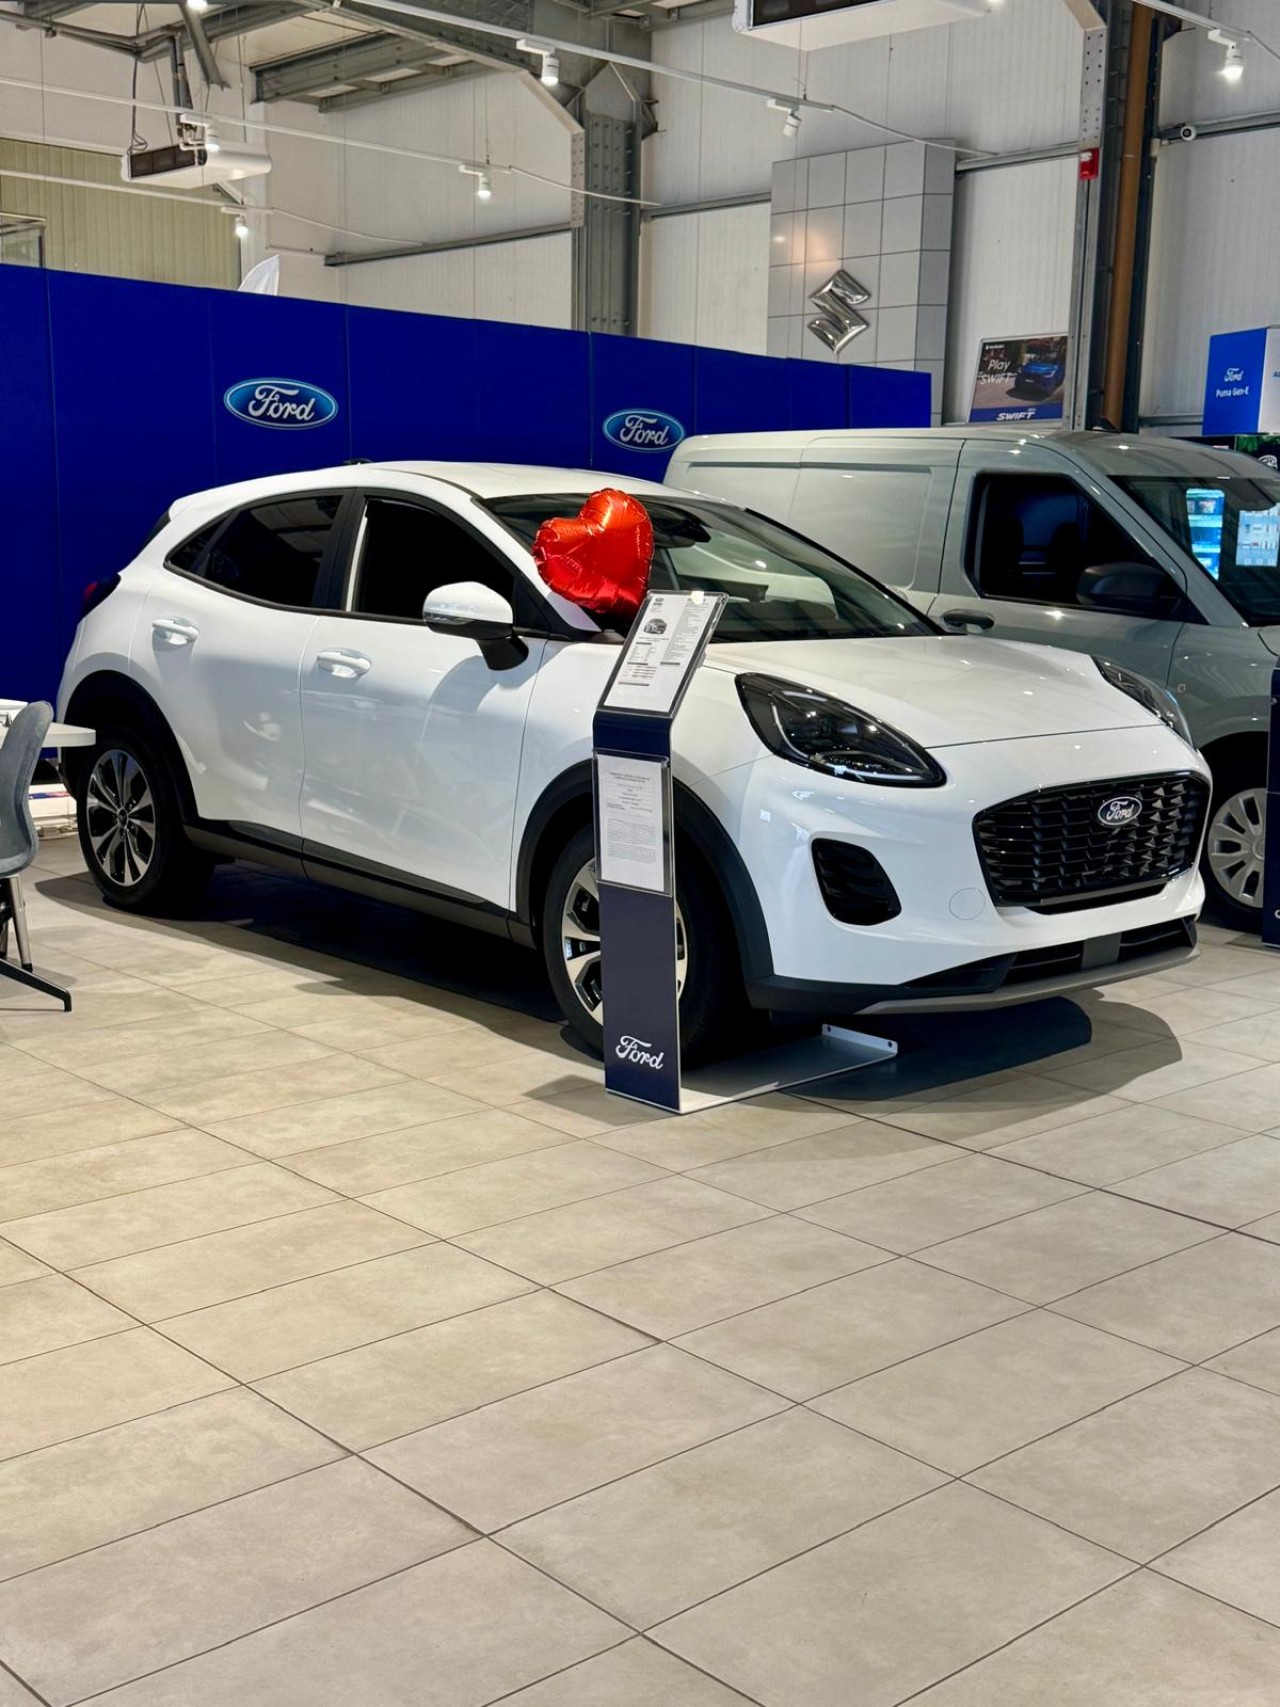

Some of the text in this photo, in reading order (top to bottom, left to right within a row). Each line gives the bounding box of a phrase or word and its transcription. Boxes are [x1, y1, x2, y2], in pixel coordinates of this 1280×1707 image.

[987, 358, 1012, 371] Play
[978, 372, 1018, 385] SWIFT
[1224, 367, 1244, 382] Ford
[1215, 388, 1232, 398] Puma
[247, 384, 316, 421] Ford
[996, 411, 1036, 421] SWIFT
[619, 414, 669, 445] Ford
[1106, 800, 1135, 820] Ford
[615, 1035, 664, 1070] Ford
